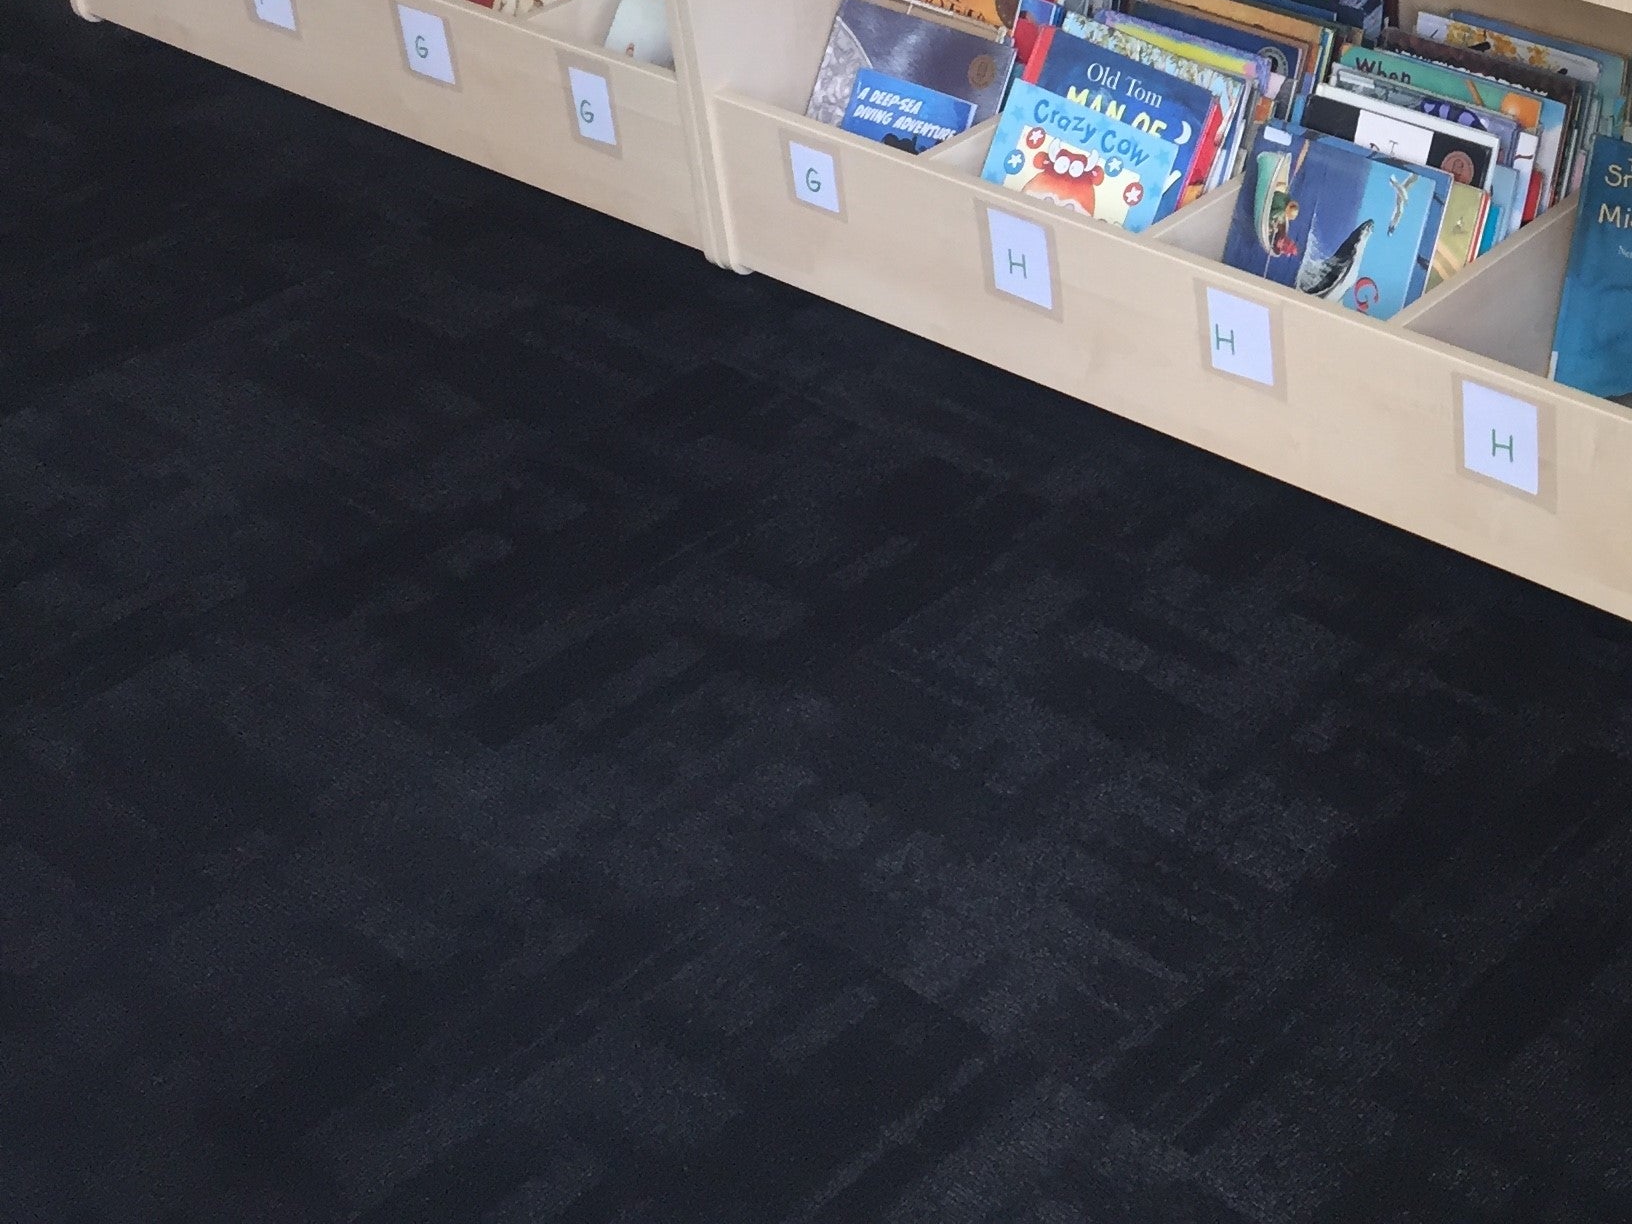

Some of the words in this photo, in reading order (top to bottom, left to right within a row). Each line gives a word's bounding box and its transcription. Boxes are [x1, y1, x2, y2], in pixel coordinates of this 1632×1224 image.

[414, 34, 429, 59] G
[1087, 61, 1118, 91] Old
[1124, 76, 1164, 109] Tom
[1355, 56, 1413, 86] When
[579, 99, 595, 124] G
[852, 104, 895, 126] DIVING
[857, 86, 871, 101] A
[868, 88, 924, 115] DEEP-SEA
[1065, 85, 1127, 120] MAN
[1033, 99, 1098, 144] Crazy
[1100, 128, 1152, 167] Cow
[804, 166, 823, 194] G
[1007, 247, 1028, 280] H
[1214, 323, 1237, 356] H
[1490, 427, 1515, 464] H
